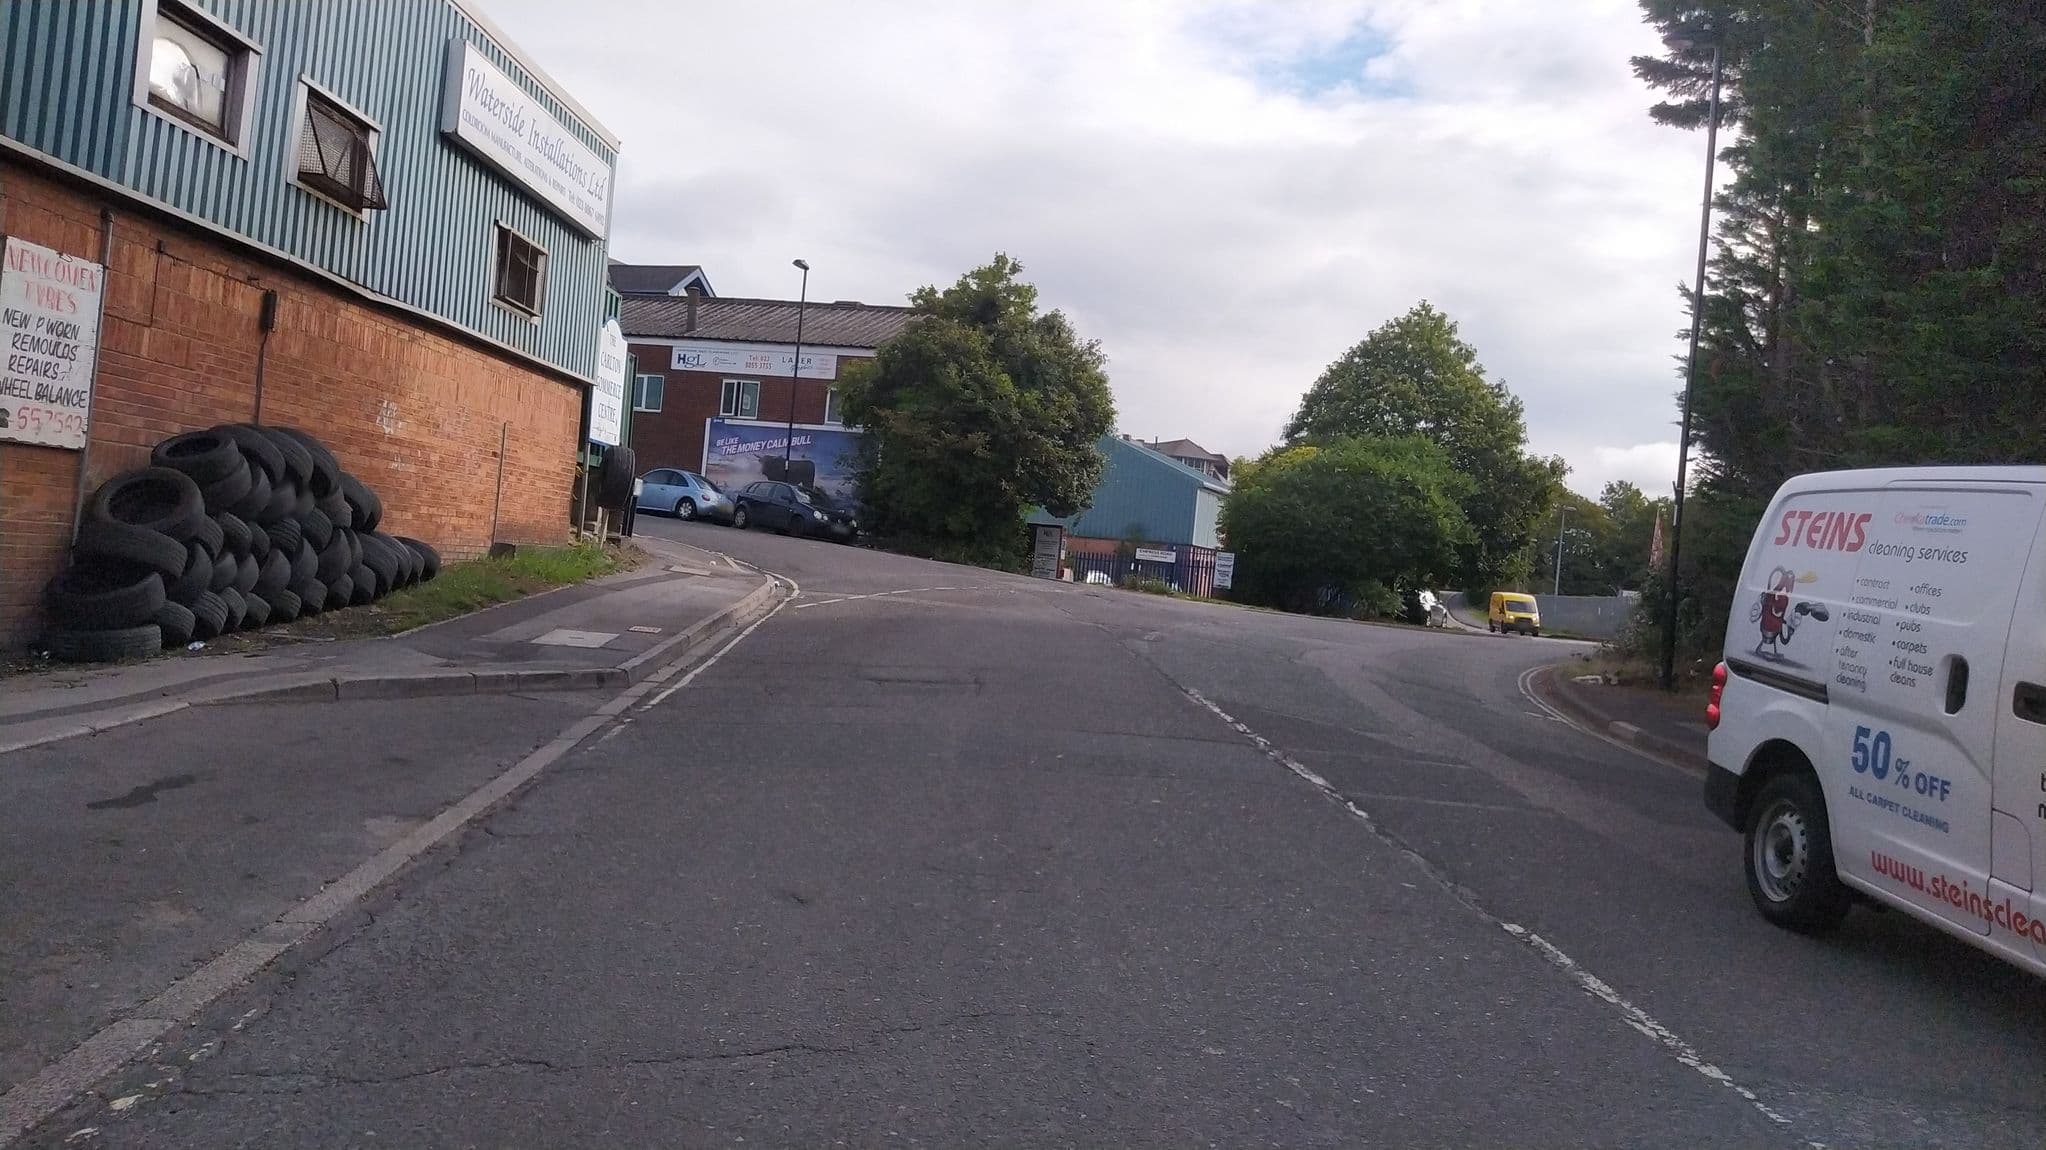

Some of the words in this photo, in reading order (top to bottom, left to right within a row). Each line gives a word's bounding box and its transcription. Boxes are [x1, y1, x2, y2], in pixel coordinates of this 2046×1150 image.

[467, 67, 525, 138] Waterside
[528, 118, 589, 190] Installations
[587, 172, 608, 202] Ltd
[2, 307, 33, 330] NEW
[45, 318, 81, 341] WORN
[11, 331, 79, 362] REMOULDS
[8, 353, 60, 381] REPAIRS
[600, 351, 622, 374] CARLTON
[782, 355, 813, 366] LAER
[34, 382, 89, 409] BALANCE
[596, 375, 623, 400] COMMERCE
[597, 402, 617, 424] CENTRE
[716, 438, 725, 448] BE
[725, 436, 740, 446] LIKE
[721, 444, 738, 456] THE
[737, 441, 766, 454] MONEY
[790, 434, 812, 447] BULL
[1773, 510, 1873, 553] STEINS
[1867, 539, 1915, 563] cleaning
[1916, 545, 1969, 565] services
[1860, 578, 1890, 590] contract
[1914, 582, 1943, 598] offices
[1855, 595, 1899, 610] commercial
[1909, 602, 1931, 616] clubs
[1846, 609, 1880, 625] industrial
[1899, 619, 1921, 633] pubs
[1842, 628, 1877, 644] domestic
[1839, 645, 1858, 659] after
[1896, 640, 1928, 655] carpets
[1838, 660, 1868, 679] tenancy
[1893, 656, 1907, 670] full
[1907, 659, 1934, 677] house
[1836, 672, 1867, 694] cleaning
[1889, 671, 1917, 688] cleans
[1915, 771, 1952, 802] OFF
[1848, 784, 1865, 801] ALL
[1866, 792, 1901, 813] CARPET
[1902, 806, 1949, 834] CLEANING
